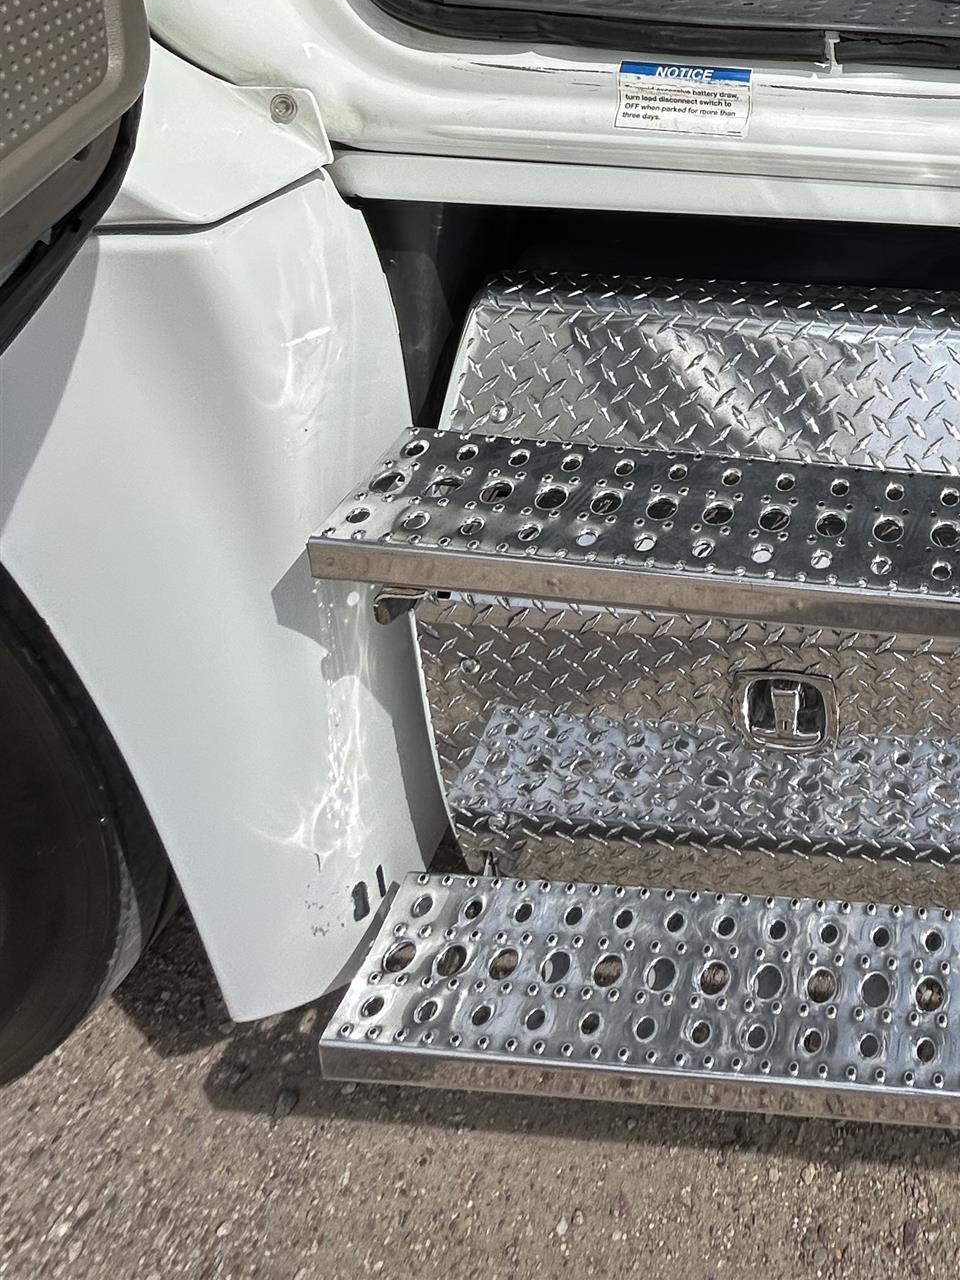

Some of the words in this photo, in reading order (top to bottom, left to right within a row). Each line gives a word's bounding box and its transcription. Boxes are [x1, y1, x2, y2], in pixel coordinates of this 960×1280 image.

[655, 66, 715, 81] NOTICE
[658, 96, 698, 105] disconnect
[699, 99, 723, 107] switch
[624, 102, 640, 110] OFF
[661, 106, 687, 114] parked
[688, 106, 699, 115] for
[641, 113, 661, 121] days.
